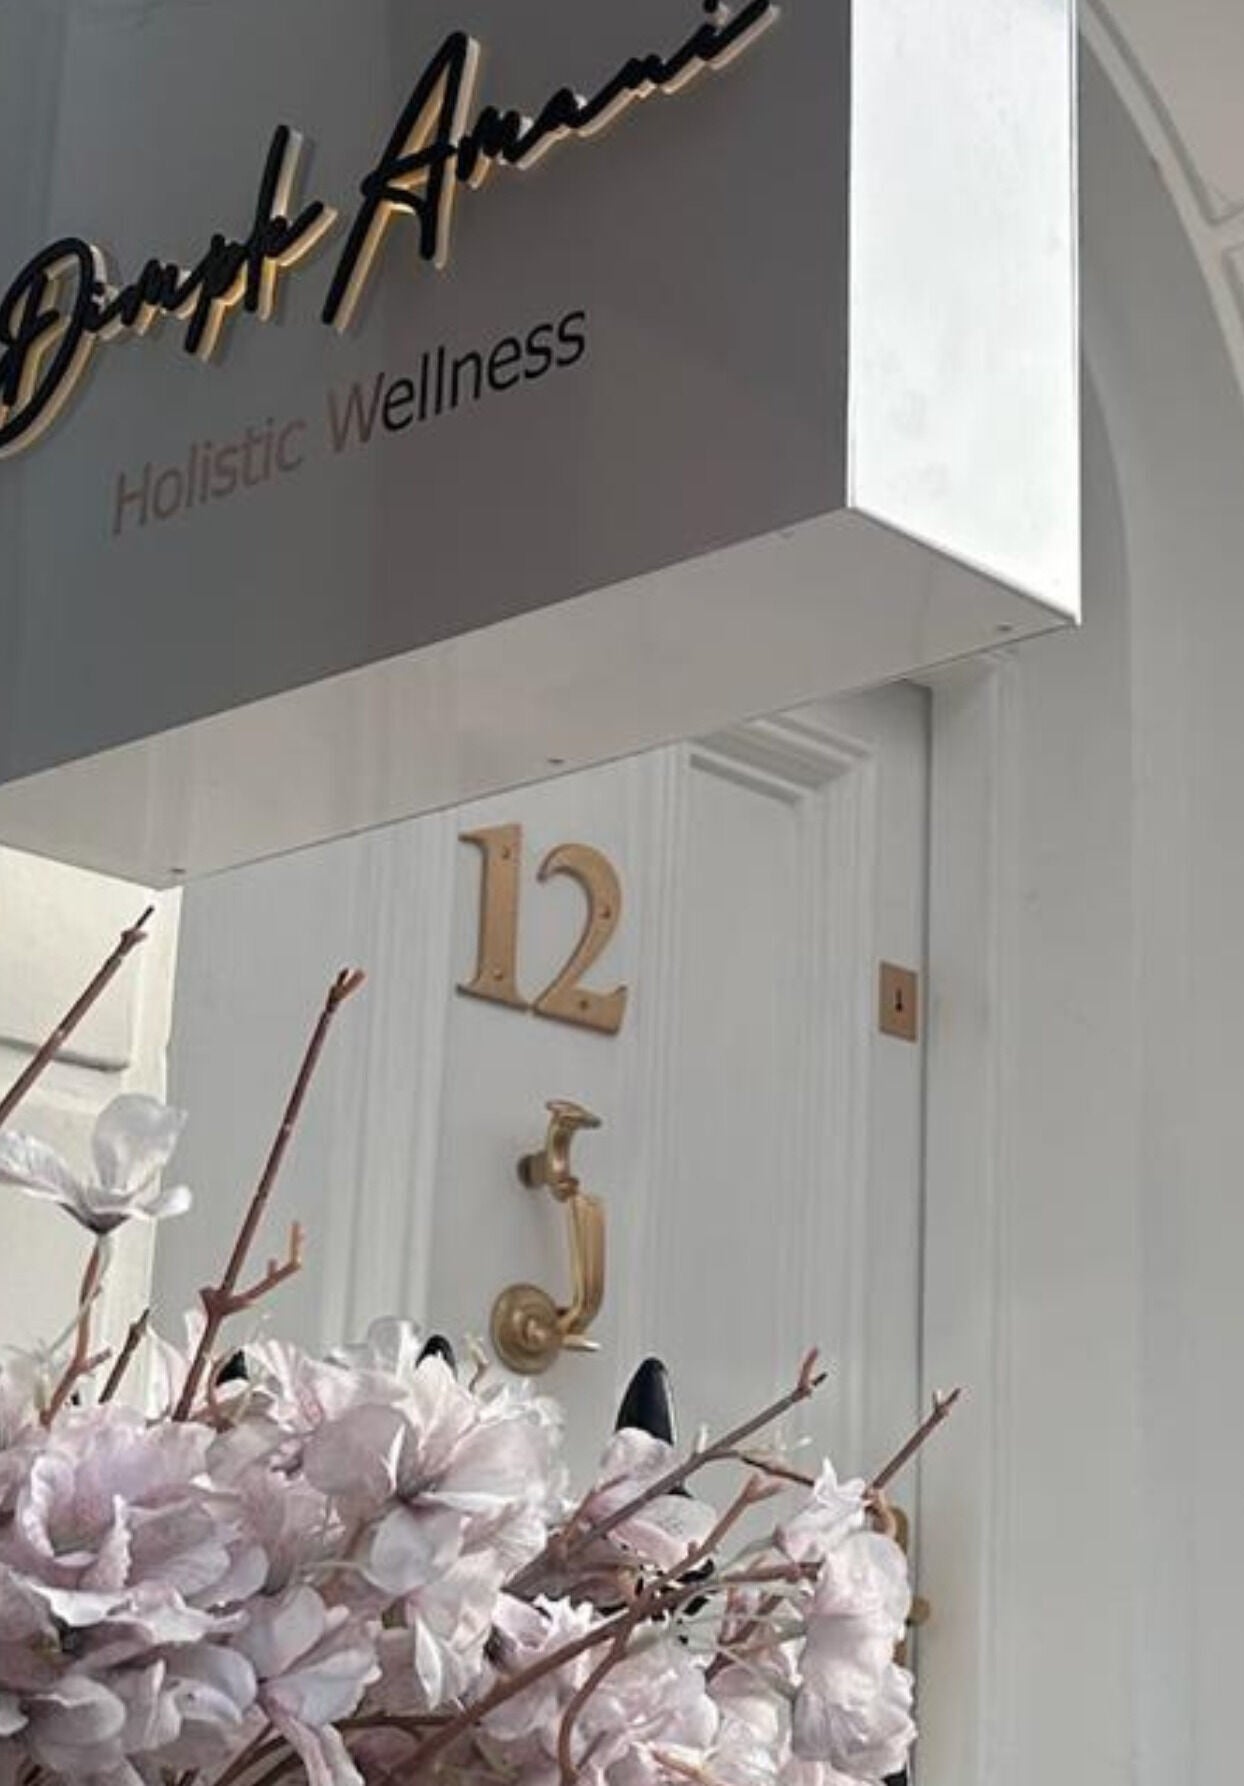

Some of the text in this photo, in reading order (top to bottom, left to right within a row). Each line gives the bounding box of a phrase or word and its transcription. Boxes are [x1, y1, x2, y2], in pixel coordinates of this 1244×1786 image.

[111, 309, 588, 537] Holistic Wellness
[456, 822, 628, 1036] 12
